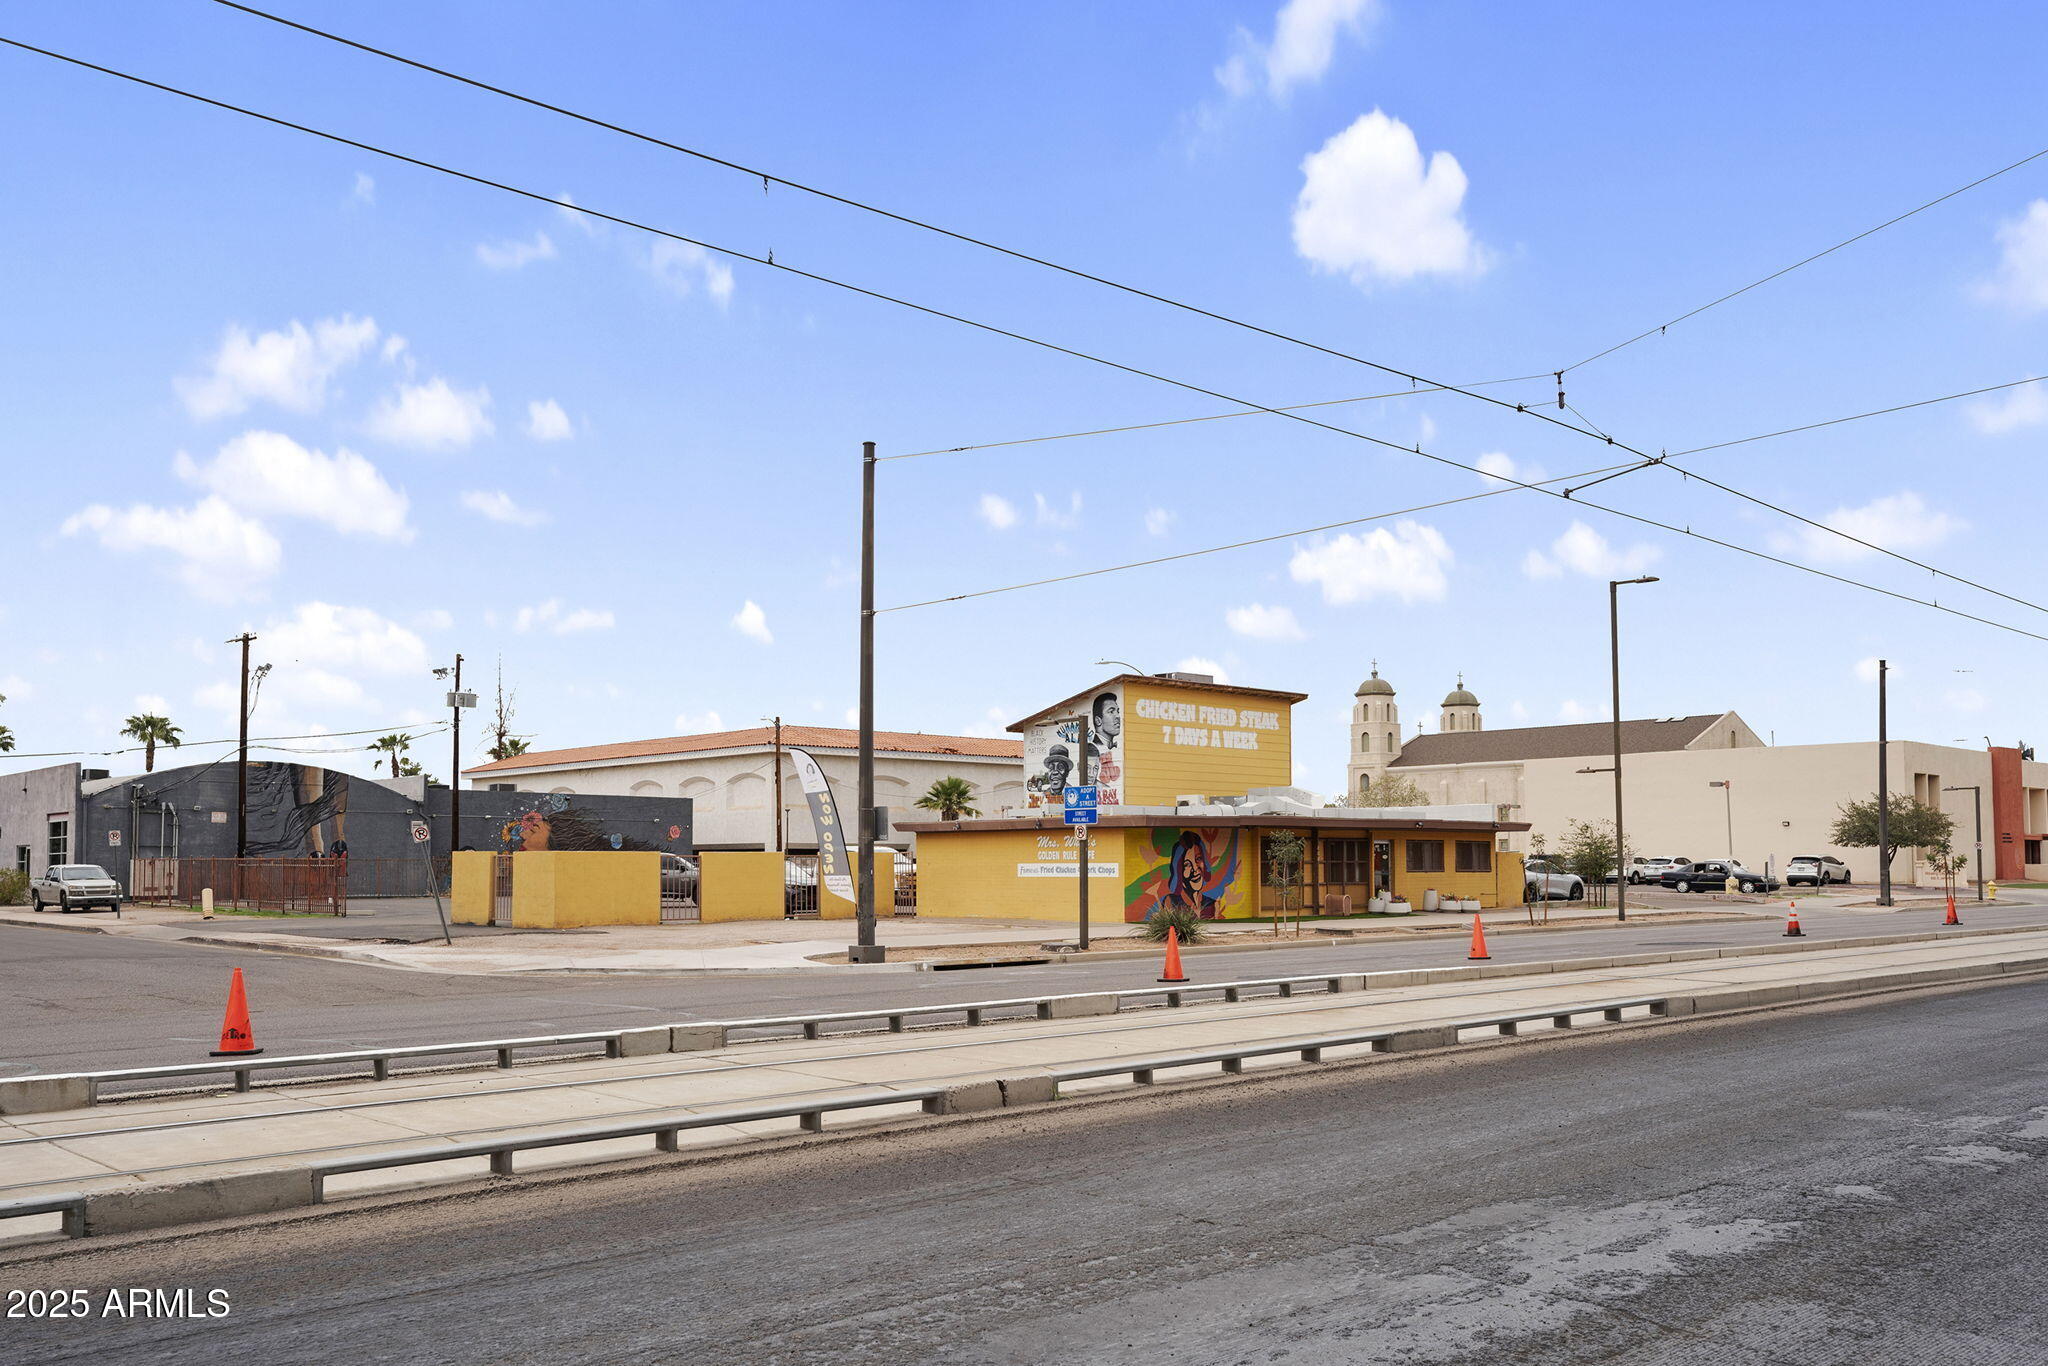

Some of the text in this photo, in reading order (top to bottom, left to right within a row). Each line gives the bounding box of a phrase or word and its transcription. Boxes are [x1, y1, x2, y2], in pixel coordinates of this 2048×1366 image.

[1136, 699, 1280, 730] CHICKEN FRIED STEAK
[1056, 721, 1094, 738] MUHAMD
[1162, 726, 1259, 750] 7 DAYS A WEEK
[1036, 835, 1097, 848] Mrs. Wh's
[1038, 851, 1059, 860] GOLDEN
[1063, 851, 1077, 860] RULE
[1040, 866, 1054, 874] Fried
[1055, 866, 1077, 874] Chicken
[1098, 866, 1116, 876] Chops
